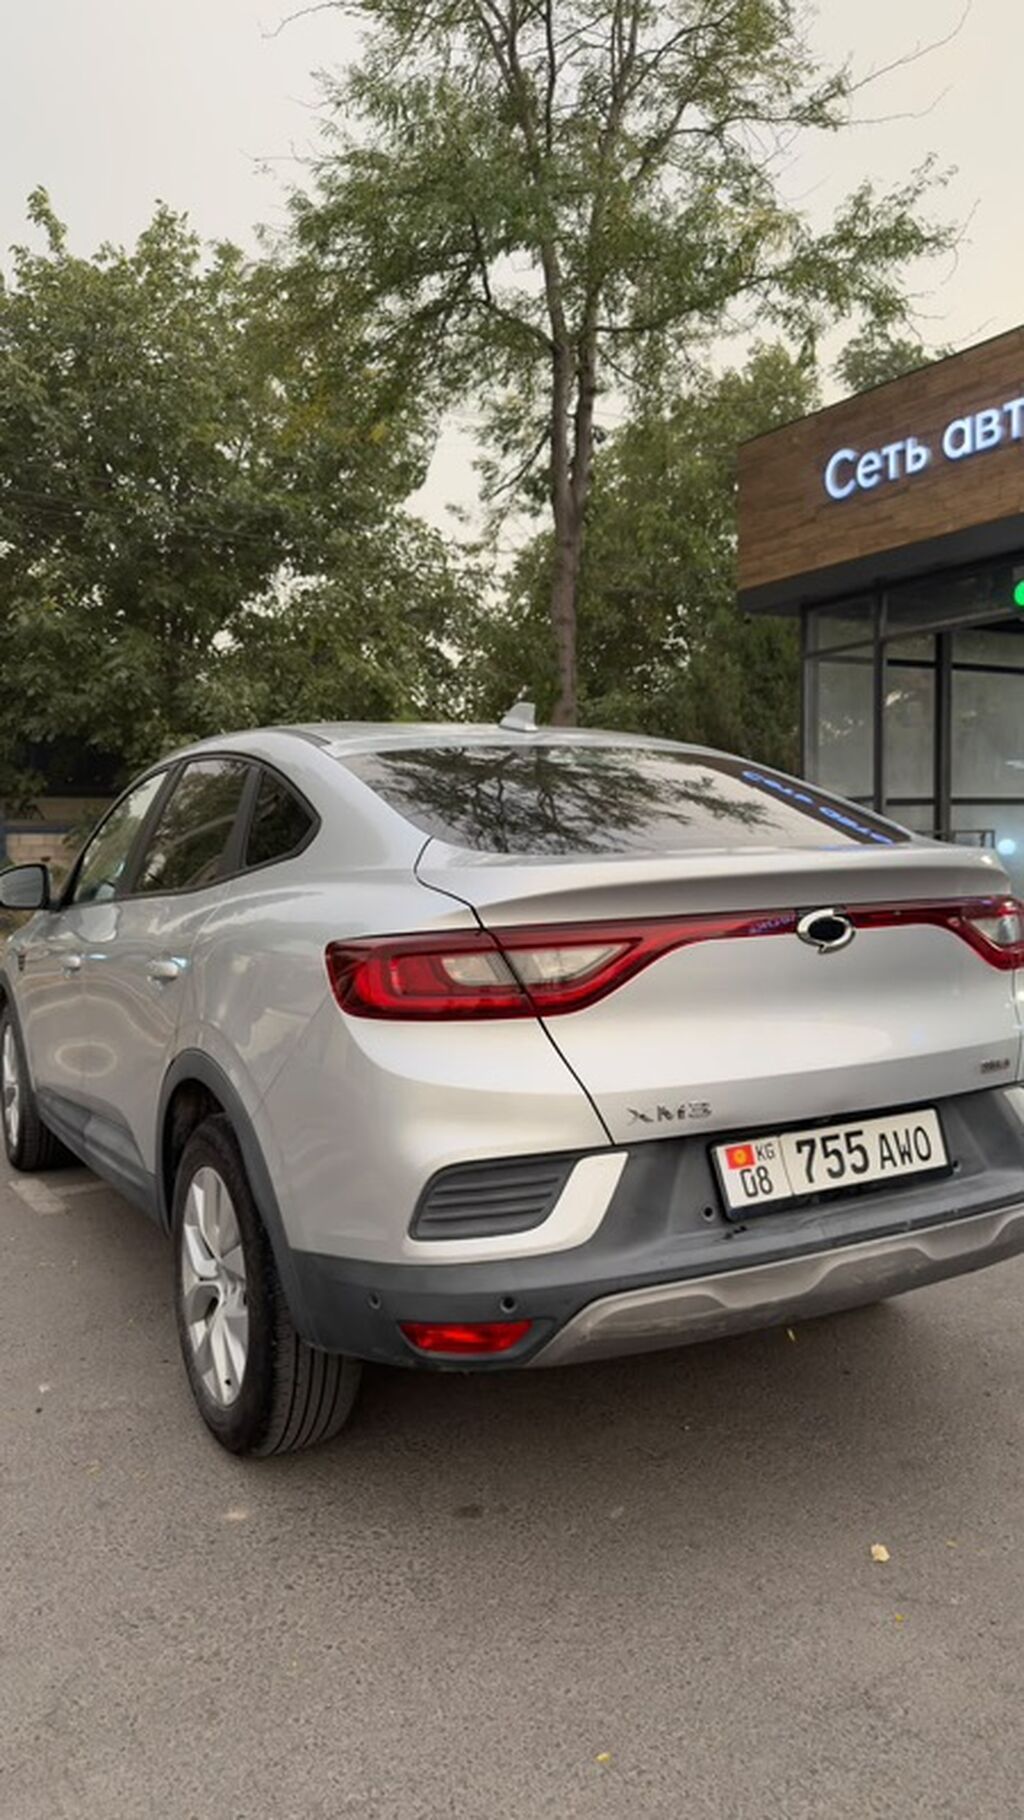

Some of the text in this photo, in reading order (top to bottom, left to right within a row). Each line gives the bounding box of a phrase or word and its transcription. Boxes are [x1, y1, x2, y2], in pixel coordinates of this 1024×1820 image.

[824, 436, 931, 500] Сеть
[626, 1100, 712, 1126] XM3
[755, 1142, 775, 1161] KG
[796, 1126, 932, 1184] 755 AWO
[740, 1165, 774, 1198] 08
